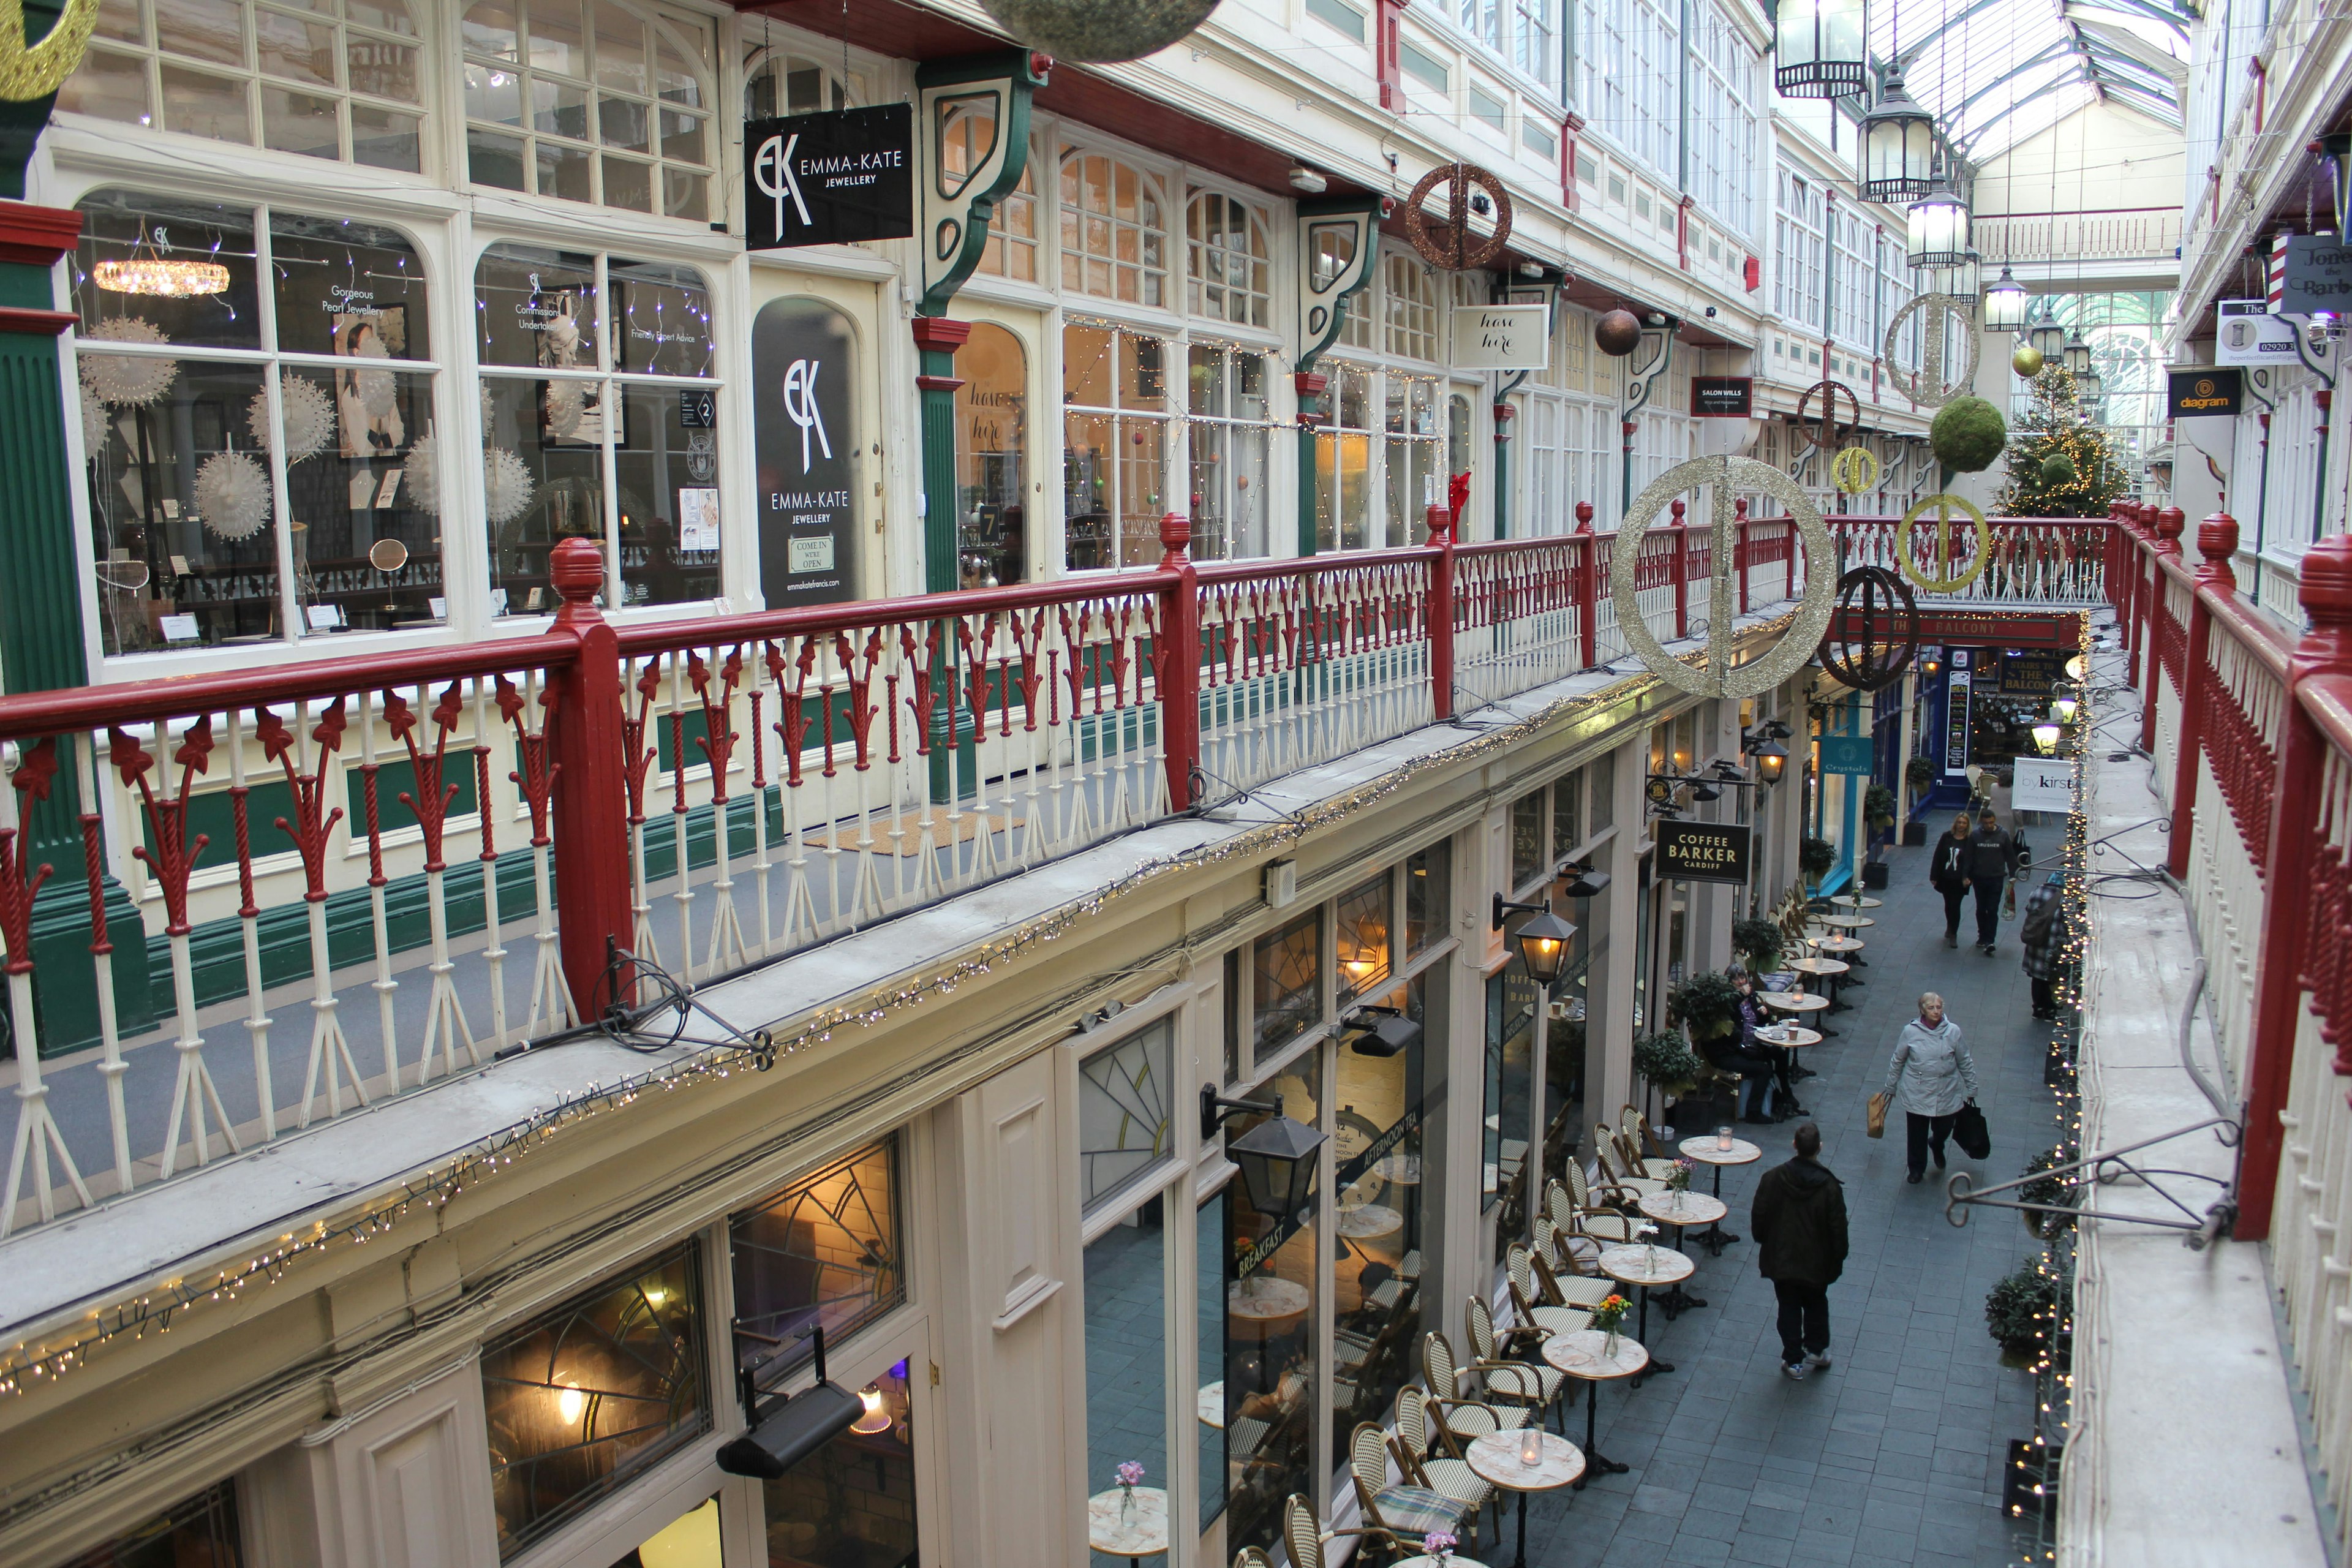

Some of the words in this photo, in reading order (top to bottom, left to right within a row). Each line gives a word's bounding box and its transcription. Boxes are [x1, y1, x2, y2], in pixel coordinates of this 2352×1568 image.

[801, 151, 902, 175] EMMA-KATE
[826, 175, 876, 187] JEWELLERY
[2325, 266, 2341, 276] the
[331, 285, 374, 300] Gorgeous
[322, 301, 344, 312] Pearl
[347, 303, 384, 318] Jewellery
[516, 304, 560, 317] Commissions
[2244, 304, 2263, 314] The
[1480, 313, 1516, 327] have
[631, 329, 655, 341] Friendly
[676, 333, 695, 342] Advice
[1482, 334, 1515, 361] hire
[971, 382, 1000, 407] have
[2180, 397, 2228, 409] diagram
[703, 404, 709, 417] 2
[973, 416, 1003, 451] hire
[771, 491, 848, 510] EMMA-KATE
[792, 514, 831, 524] JEWELLERY
[984, 514, 995, 535] 7
[797, 541, 818, 550] COME
[803, 559, 821, 568] OPEN
[787, 579, 840, 591] emmakatefrancis.com
[1894, 620, 1907, 631] TH
[1936, 622, 1996, 633] BALCONY
[2019, 670, 2043, 679] THE
[1679, 834, 1728, 846] COFFEE
[1668, 845, 1736, 862] BARKER
[1364, 1120, 1404, 1169] AFTERNOON
[1406, 1111, 1417, 1130] TEA
[1239, 1224, 1284, 1279] BREAKFAST
